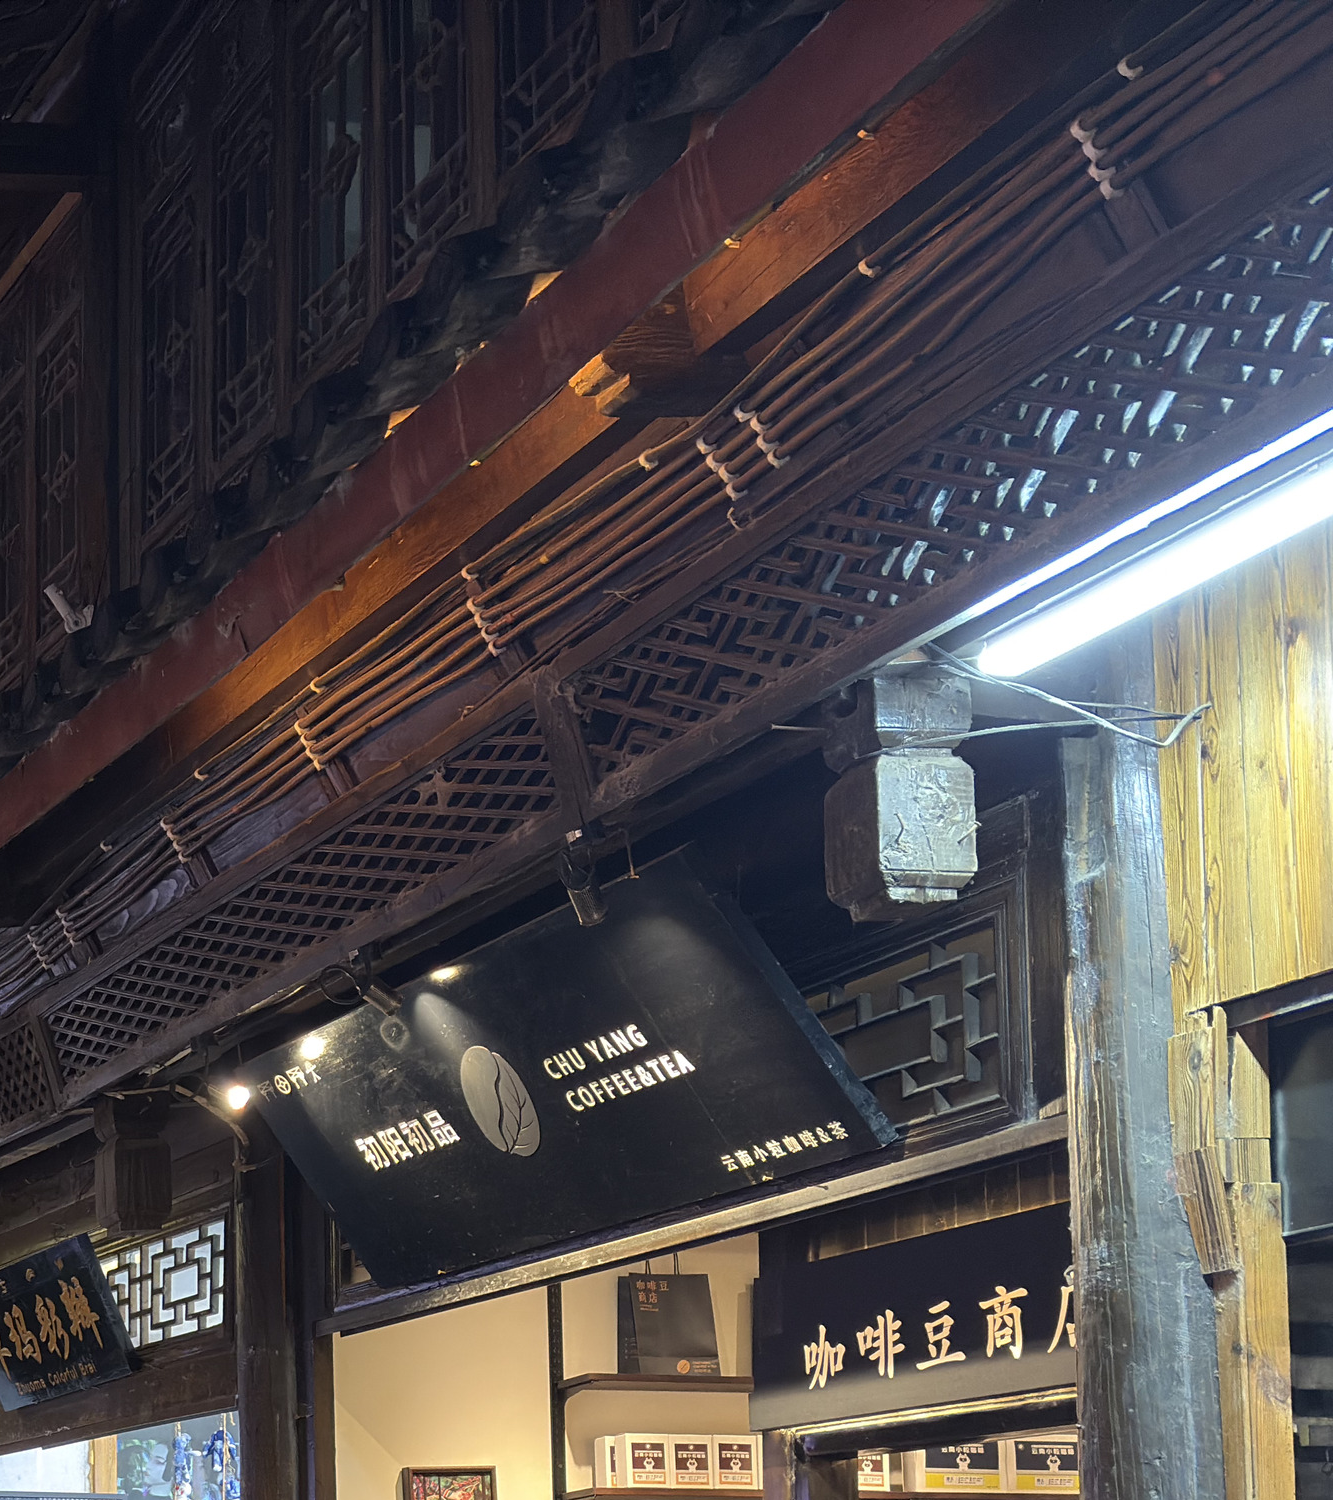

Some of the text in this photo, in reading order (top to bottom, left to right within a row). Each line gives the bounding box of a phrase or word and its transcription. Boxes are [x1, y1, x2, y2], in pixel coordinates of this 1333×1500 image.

[543, 1023, 649, 1079] CHU YANG
[565, 1050, 696, 1112] COFFEE&TEA
[355, 1109, 461, 1172] 初阳初品
[721, 1120, 849, 1172] 云南小粒咖啡&茶
[636, 1280, 669, 1291] 咖啡豆
